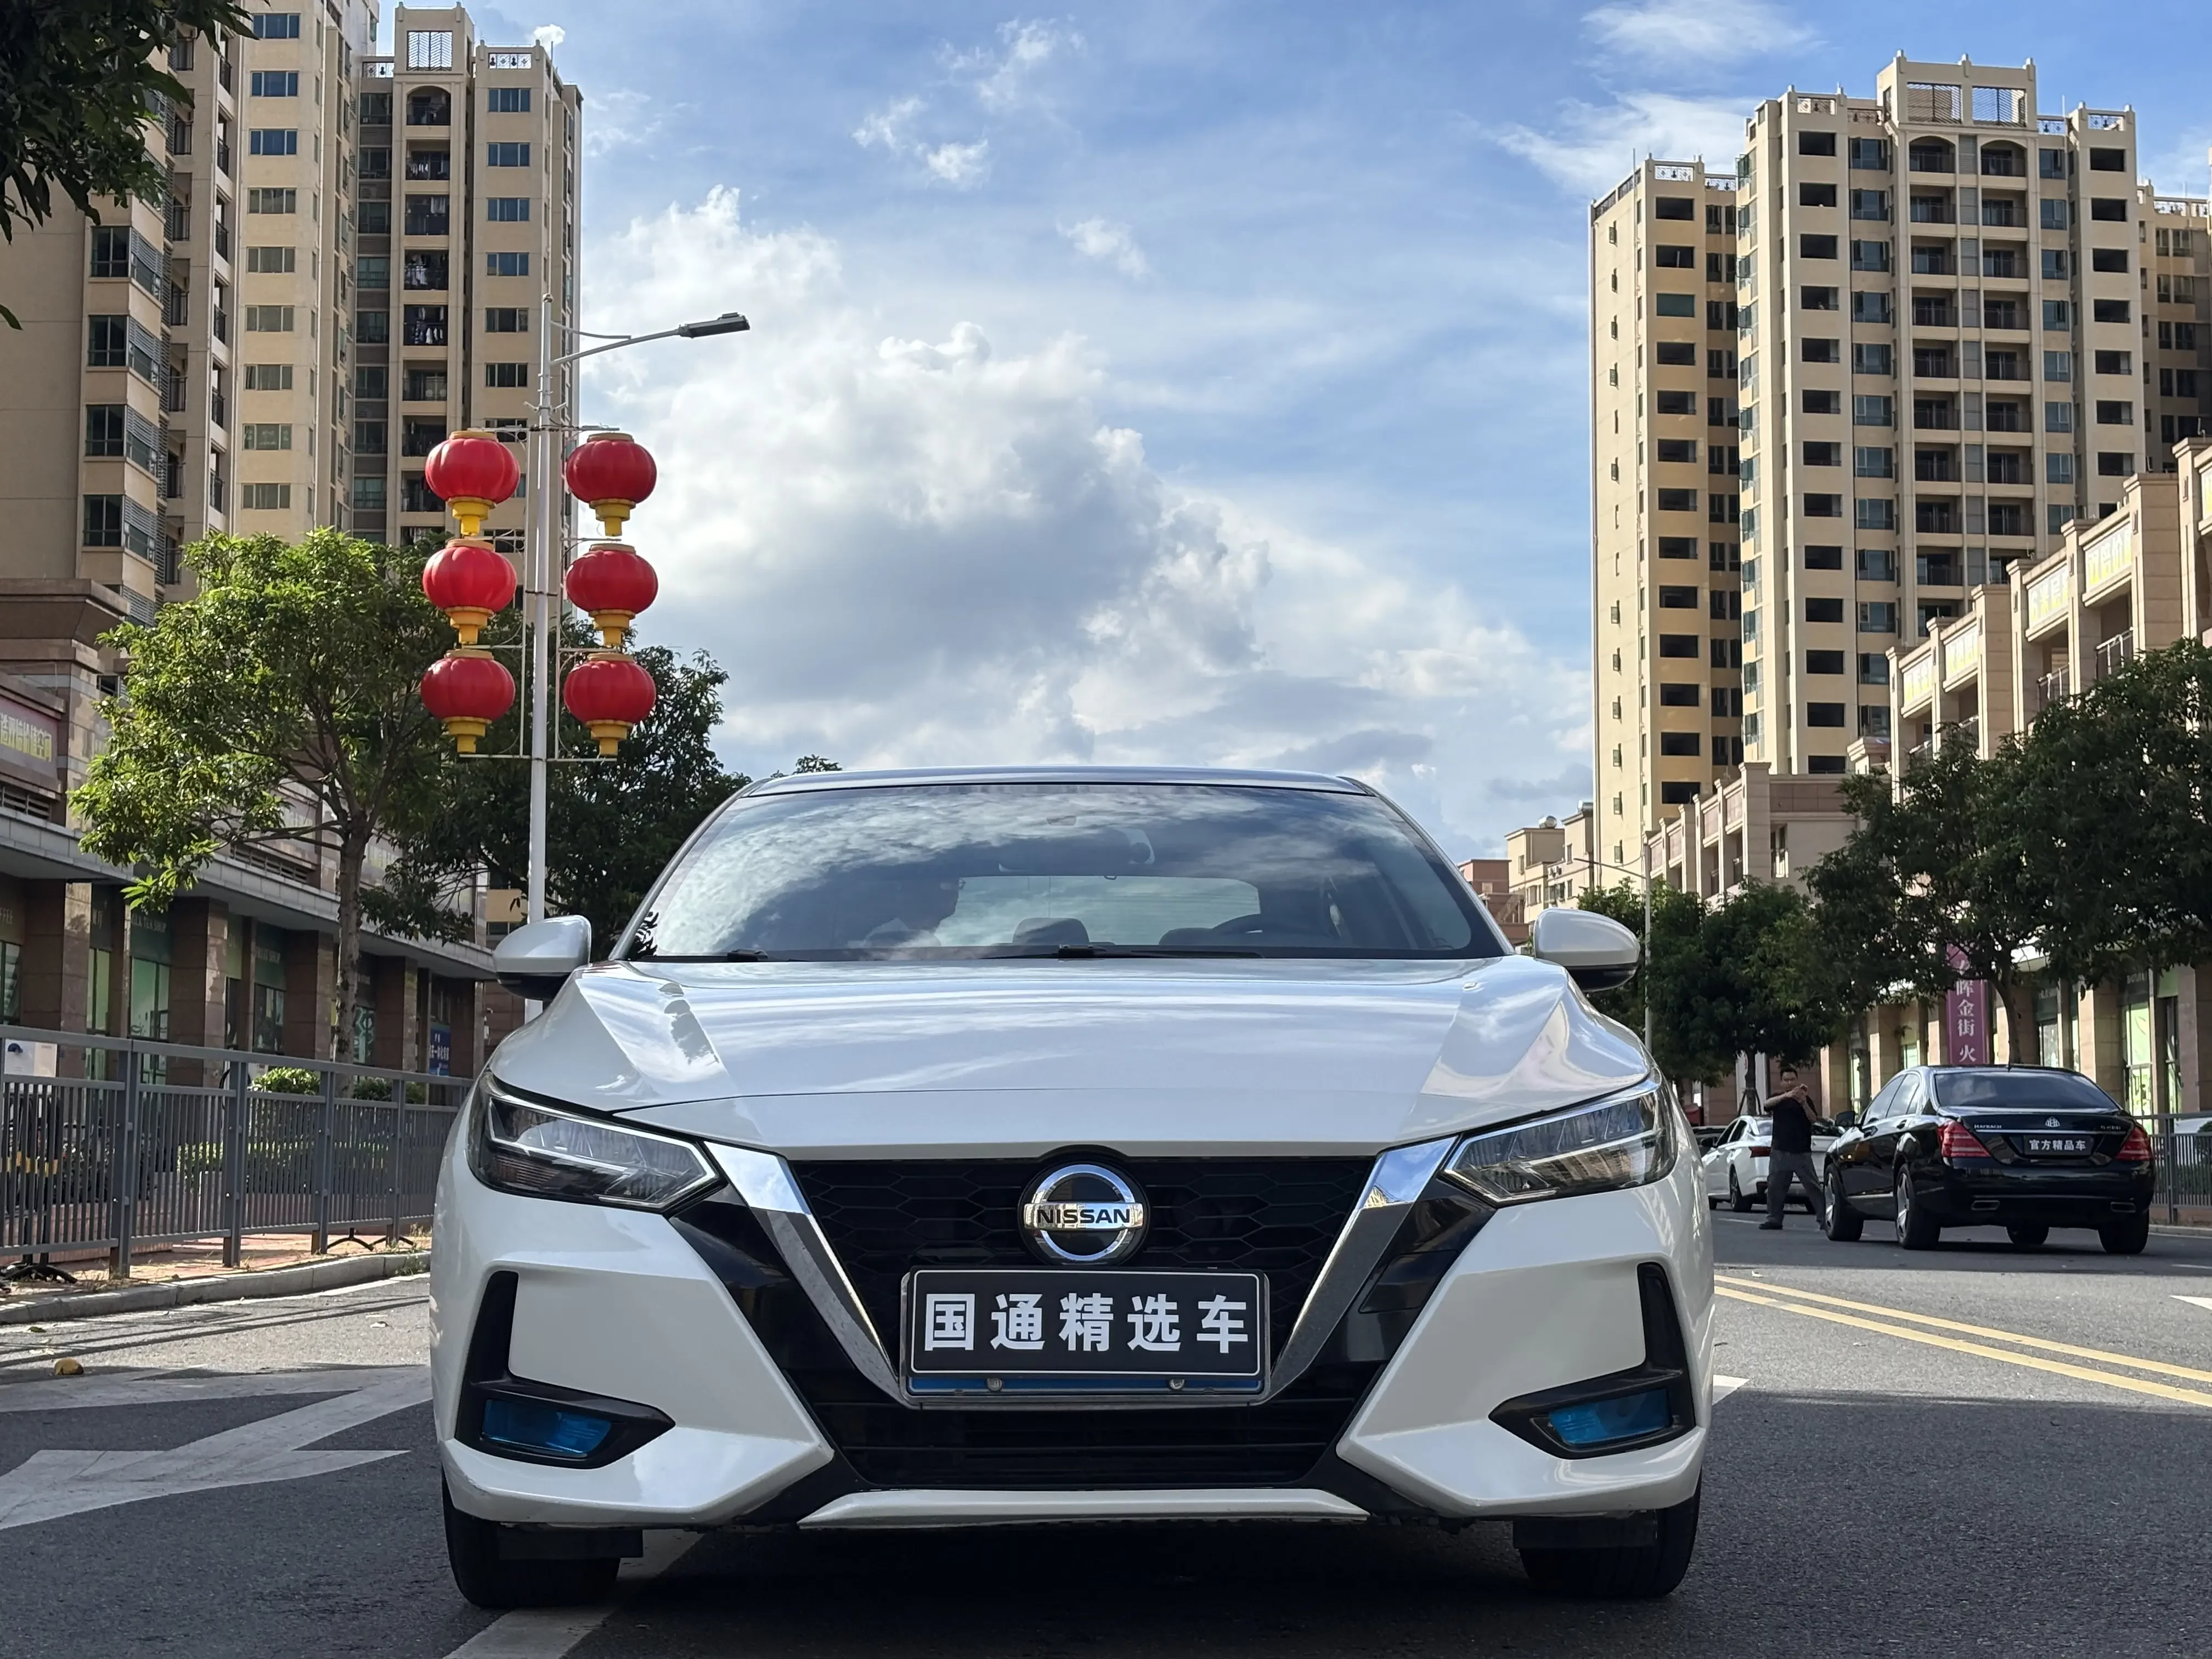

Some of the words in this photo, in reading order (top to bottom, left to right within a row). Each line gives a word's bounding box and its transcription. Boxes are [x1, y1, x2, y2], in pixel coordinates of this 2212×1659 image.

[1037, 1209, 1130, 1224] NISSAN
[924, 1292, 1249, 1354] 国通精选车
